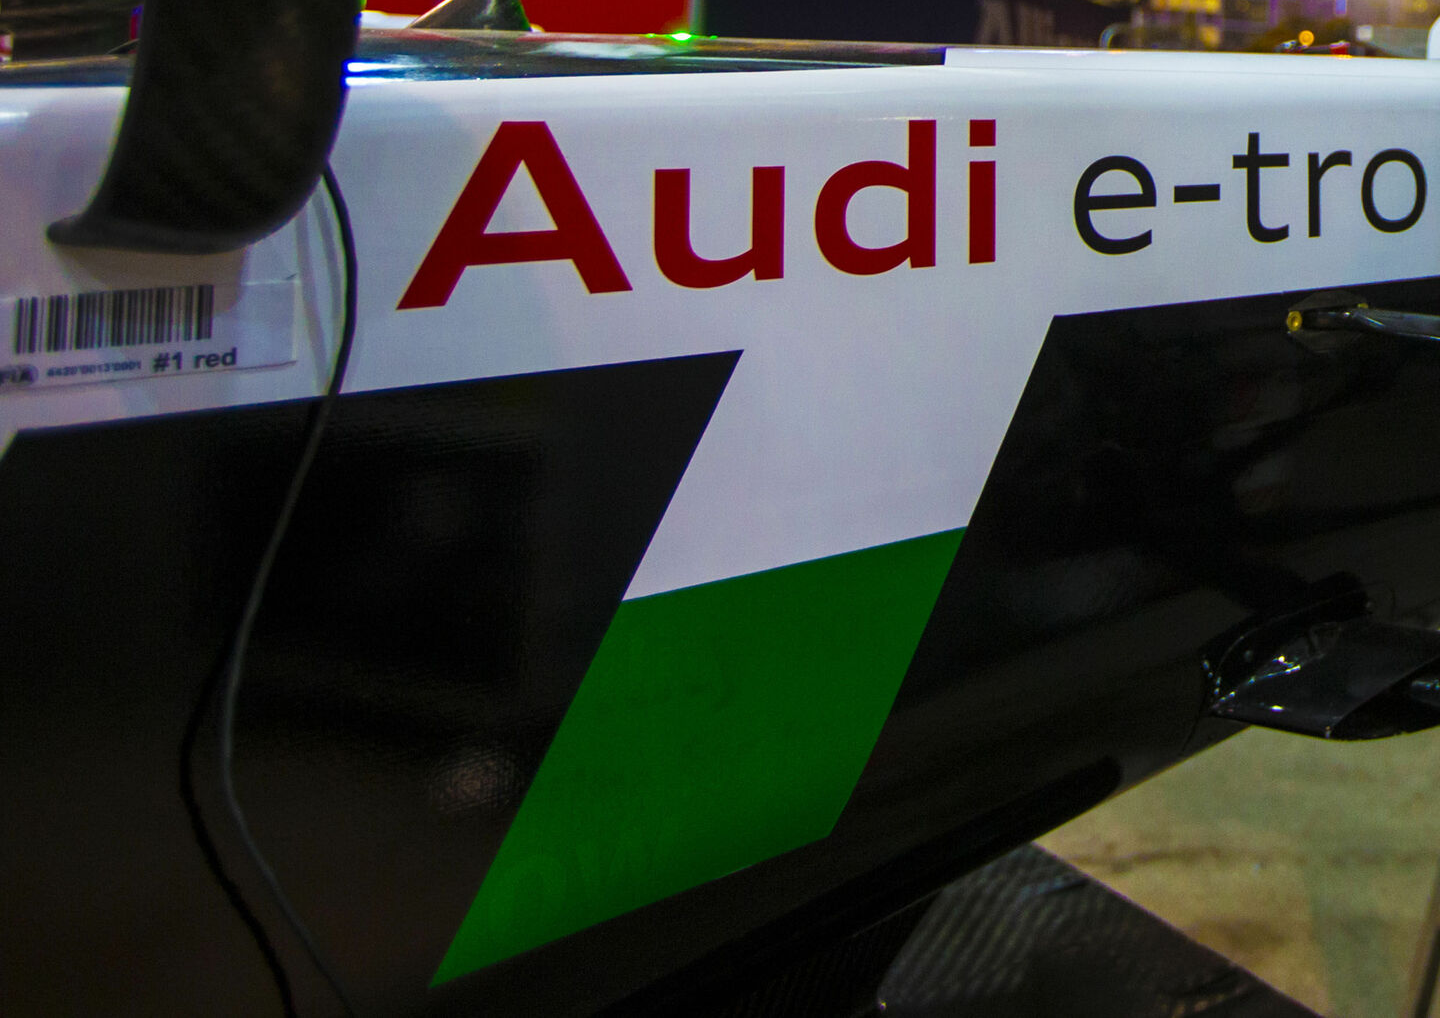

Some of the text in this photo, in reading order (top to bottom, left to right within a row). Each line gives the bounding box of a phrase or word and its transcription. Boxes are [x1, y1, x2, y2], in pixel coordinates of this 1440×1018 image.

[397, 120, 998, 310] Audi
[153, 348, 238, 372] #1 red
